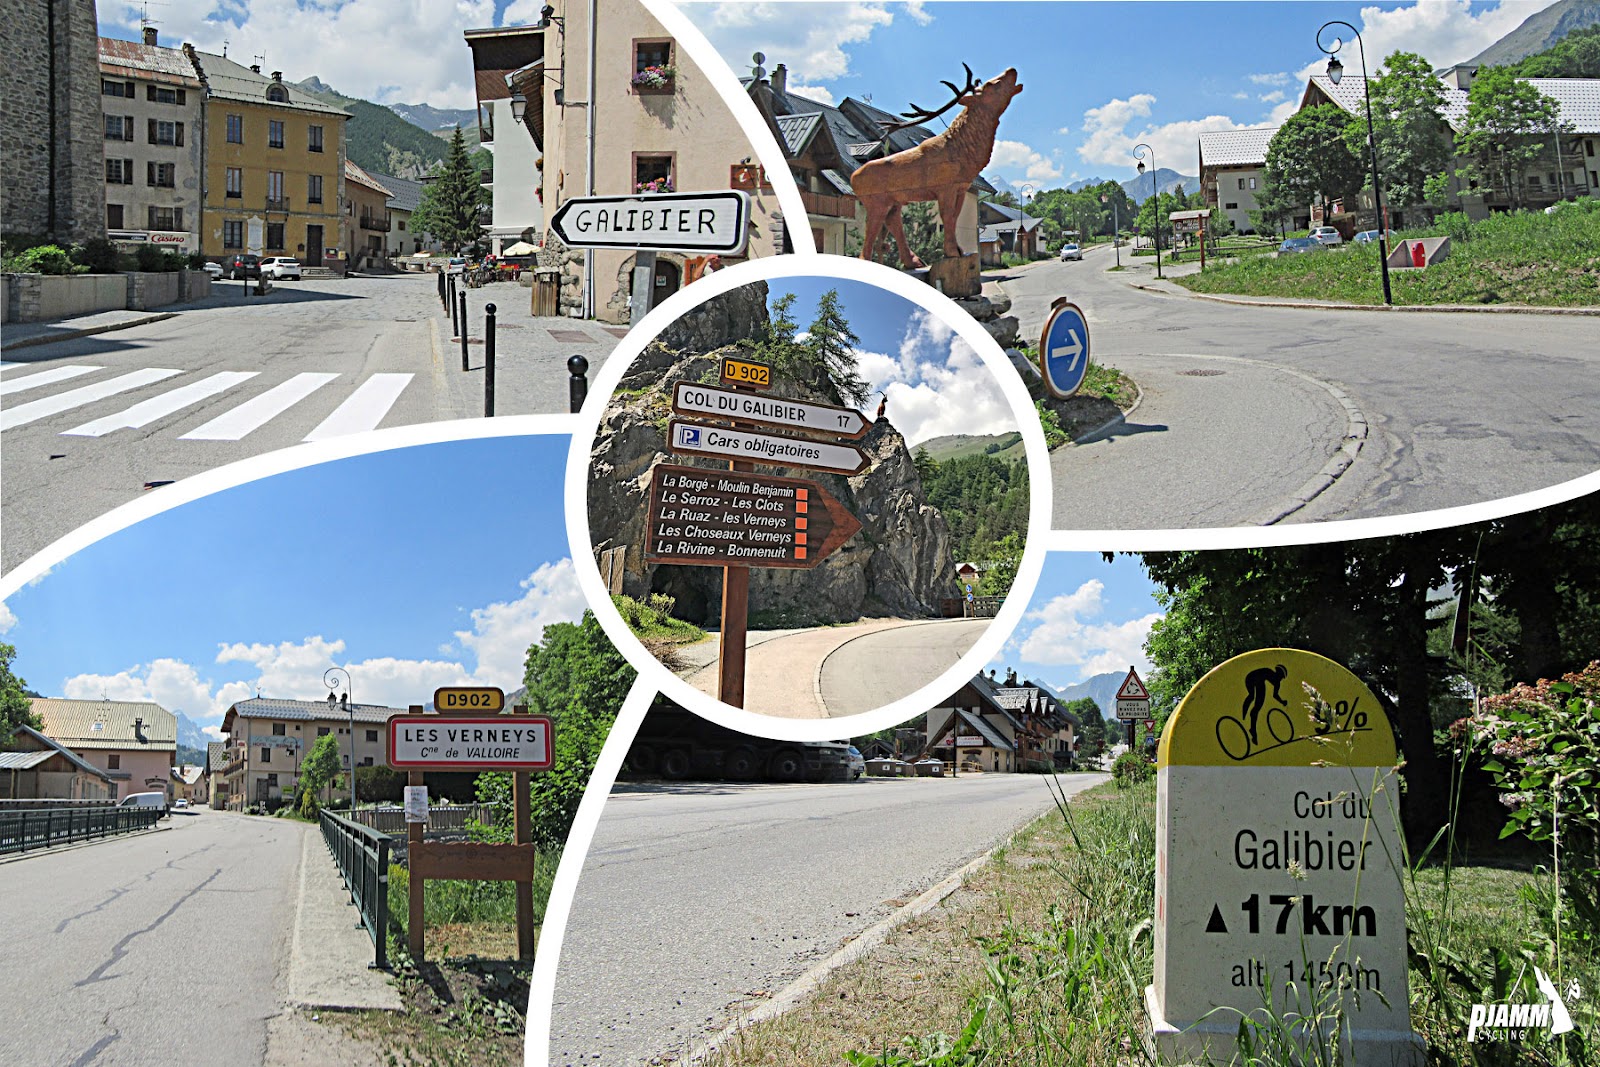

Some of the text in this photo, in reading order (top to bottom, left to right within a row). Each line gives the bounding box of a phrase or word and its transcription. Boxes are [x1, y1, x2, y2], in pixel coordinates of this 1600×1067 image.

[576, 208, 716, 234] GALIBIER
[151, 234, 185, 243] Casino
[726, 363, 769, 383] D 902
[684, 390, 851, 428] COL DU GALIBIER 17
[707, 432, 821, 460] Cars obligatoires
[662, 474, 675, 487] La
[678, 475, 709, 492] Borgé
[717, 479, 750, 494] Moulin
[752, 483, 794, 499] Benjamin
[661, 490, 677, 503] Le
[680, 492, 721, 507] Serroz
[732, 496, 752, 510] Les
[755, 498, 784, 512] Clots
[659, 507, 676, 520] La
[679, 508, 712, 522] Ruaz
[743, 513, 787, 529] Verneys
[658, 523, 792, 545] Les Choseaux Verneys
[656, 540, 673, 553] La
[676, 541, 716, 555] Rivine
[727, 544, 787, 558] Bonnenuit
[447, 693, 491, 707] D902
[405, 729, 537, 743] LES VERNEYS
[445, 747, 459, 758] de
[467, 747, 520, 759] VALLOIRE
[1294, 791, 1373, 819] Col du
[1235, 829, 1373, 871] Galibier
[1241, 893, 1377, 937] 17km
[1231, 959, 1381, 991] alt 1450m
